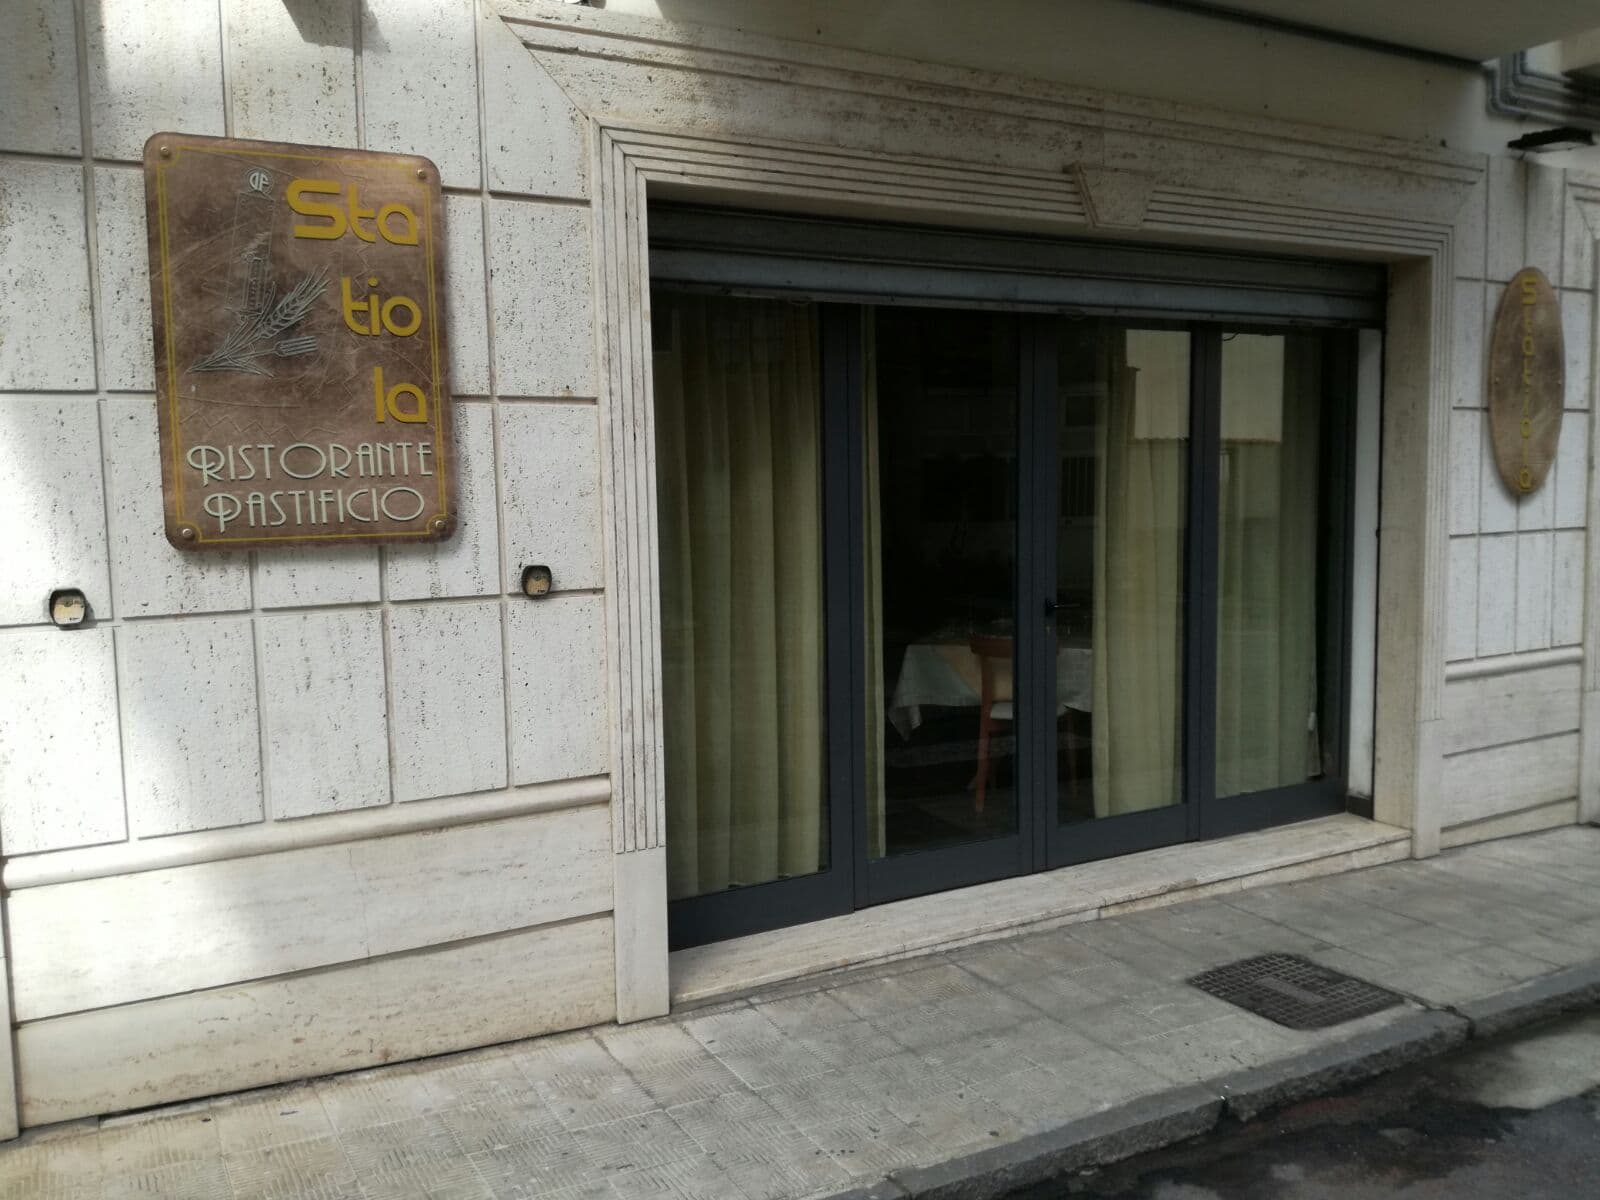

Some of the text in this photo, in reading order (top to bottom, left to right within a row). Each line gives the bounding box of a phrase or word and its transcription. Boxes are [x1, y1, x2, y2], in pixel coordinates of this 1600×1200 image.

[286, 177, 419, 246] Sta
[341, 276, 423, 337] tio
[373, 366, 429, 424] la
[186, 442, 434, 487] RISTORANTE
[203, 486, 425, 534] PASTIFICIO
